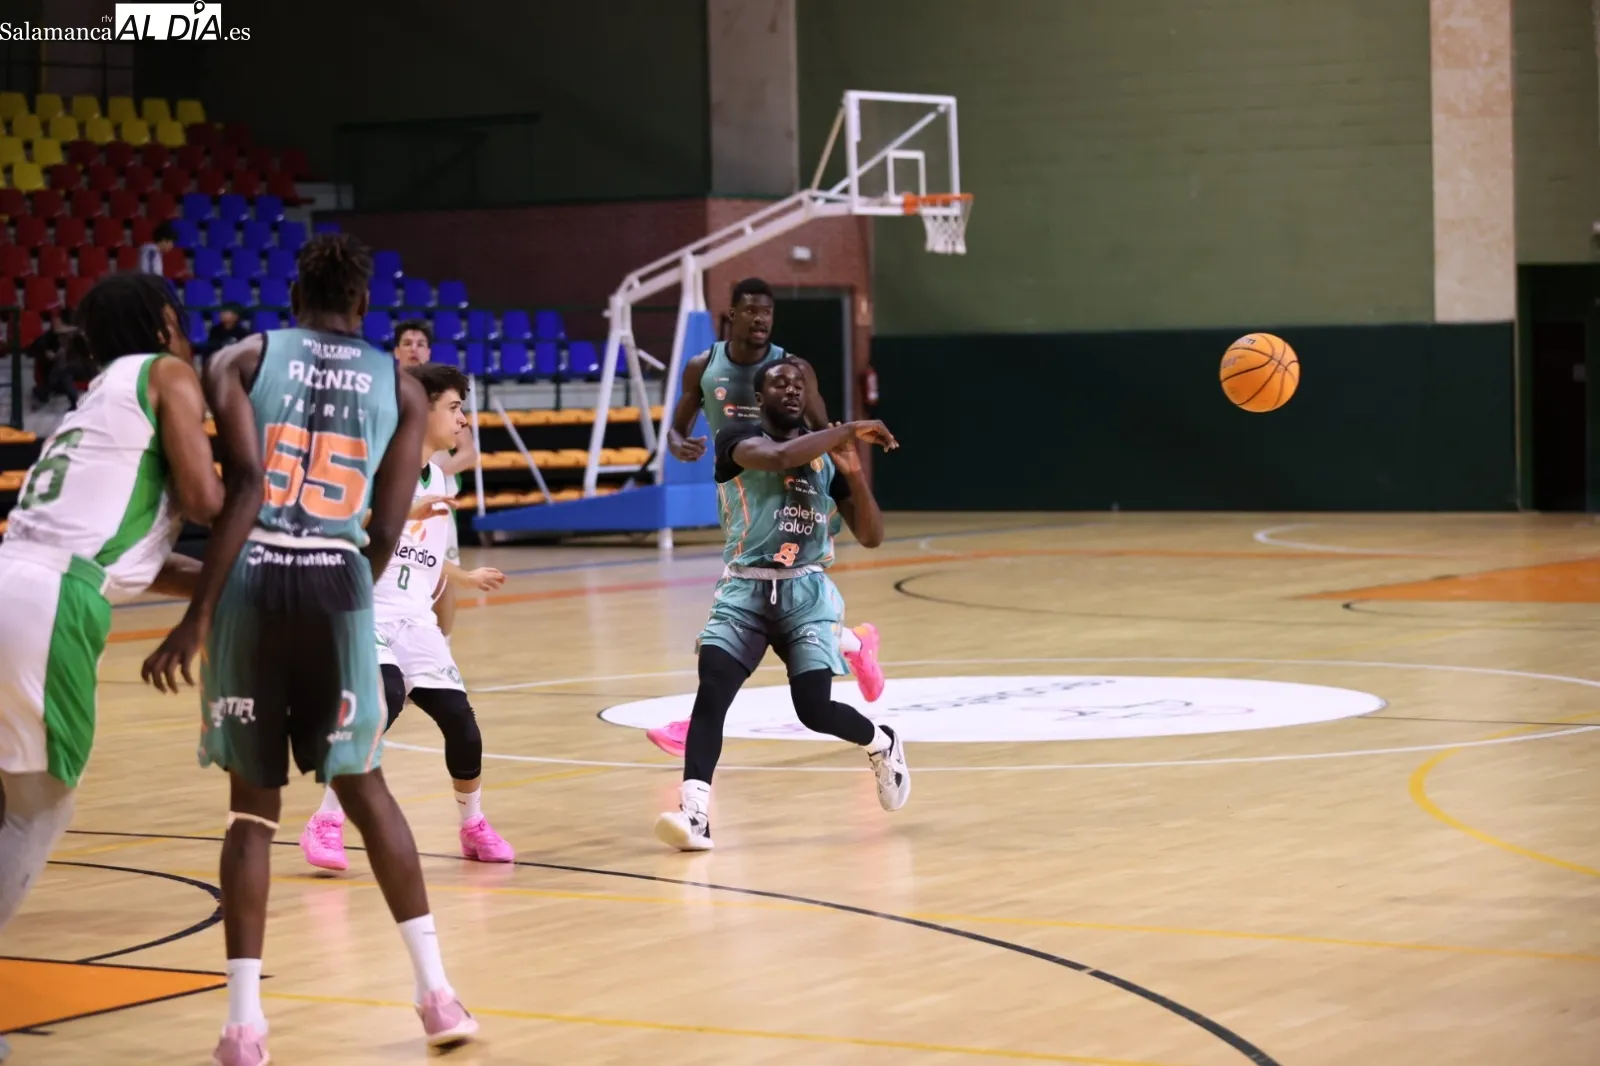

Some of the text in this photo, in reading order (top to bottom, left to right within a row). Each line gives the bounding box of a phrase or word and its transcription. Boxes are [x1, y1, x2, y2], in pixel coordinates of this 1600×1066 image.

[778, 518, 815, 536] salud
[773, 542, 800, 567] 8
[397, 565, 410, 591] 0
